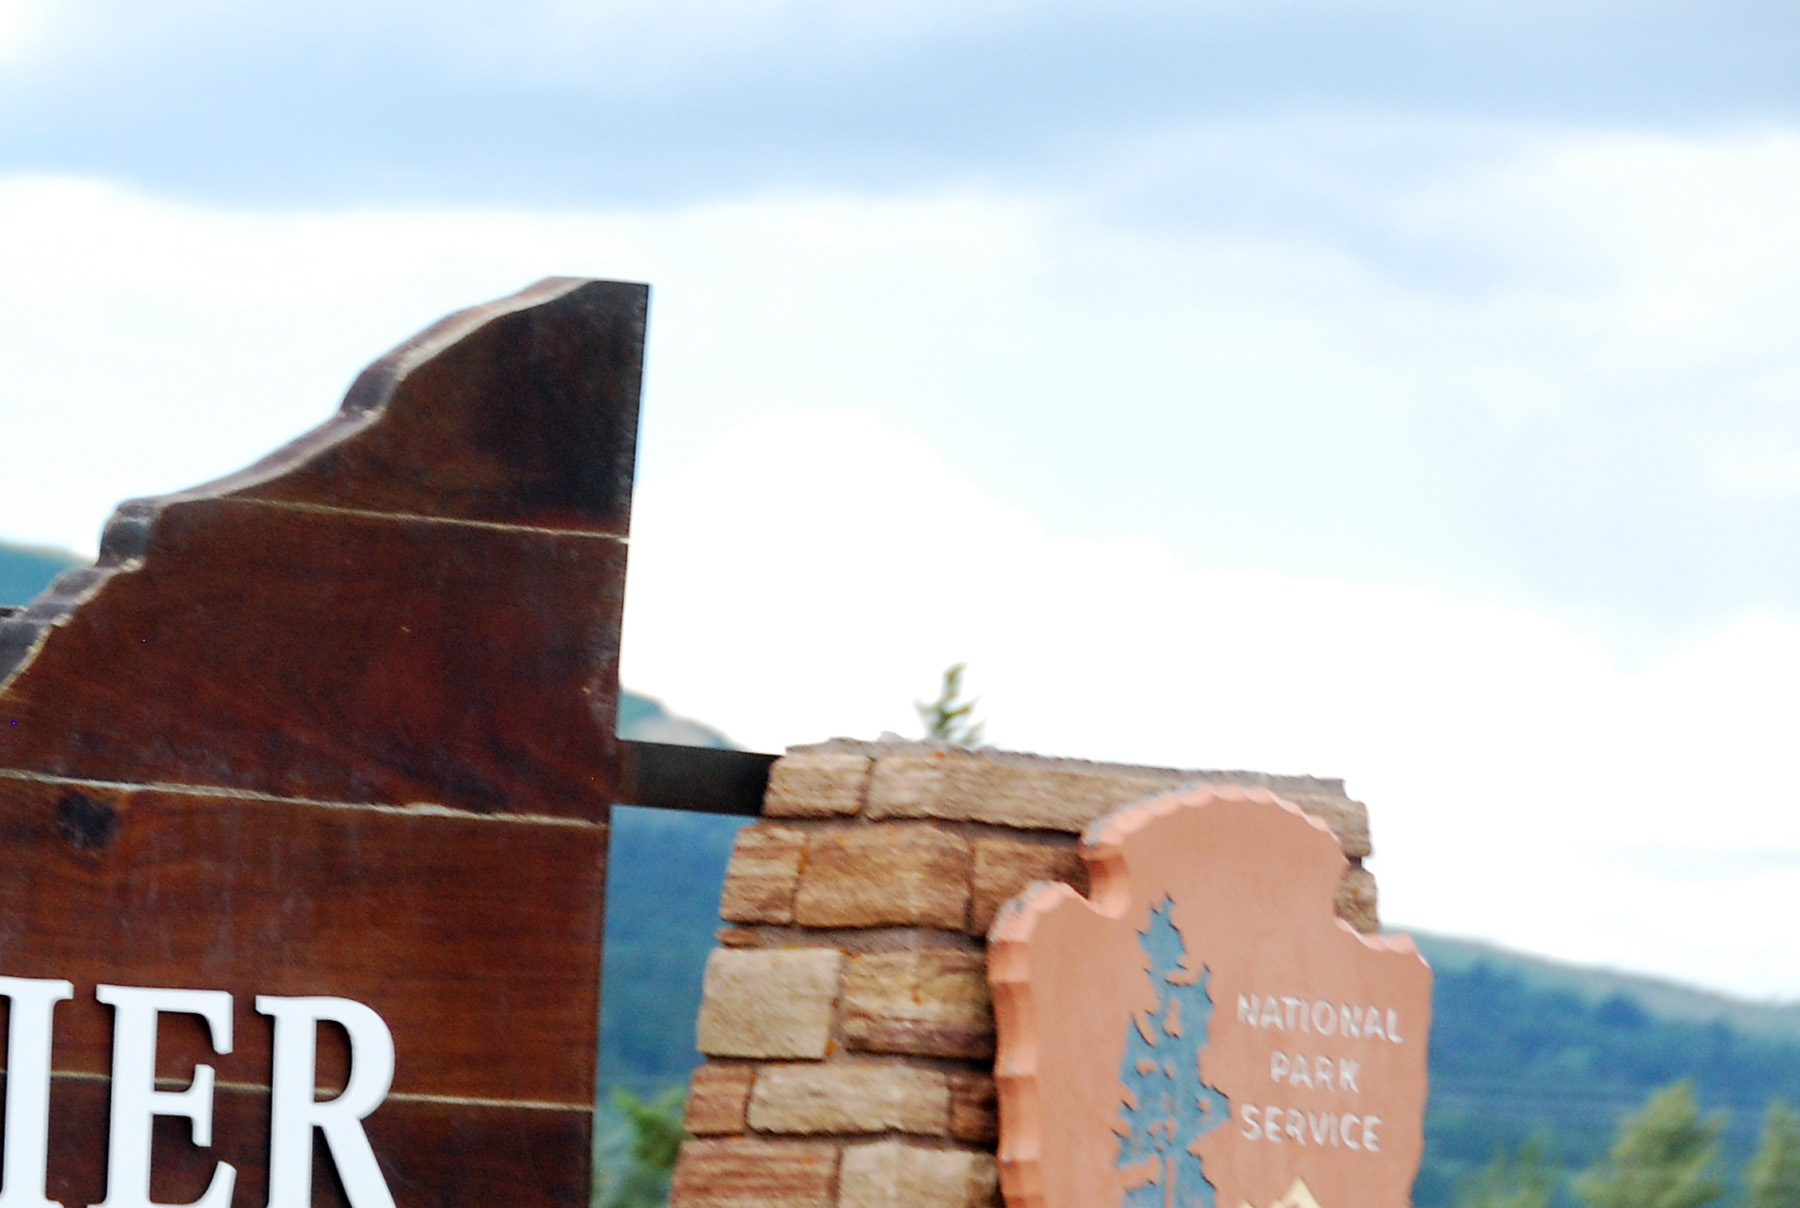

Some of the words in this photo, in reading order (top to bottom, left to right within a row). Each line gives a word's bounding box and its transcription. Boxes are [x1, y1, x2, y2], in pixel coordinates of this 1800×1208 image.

[1237, 992, 1404, 1045] NATIONAL
[1270, 1051, 1360, 1093] PARK
[1240, 1104, 1383, 1152] SERVICE
